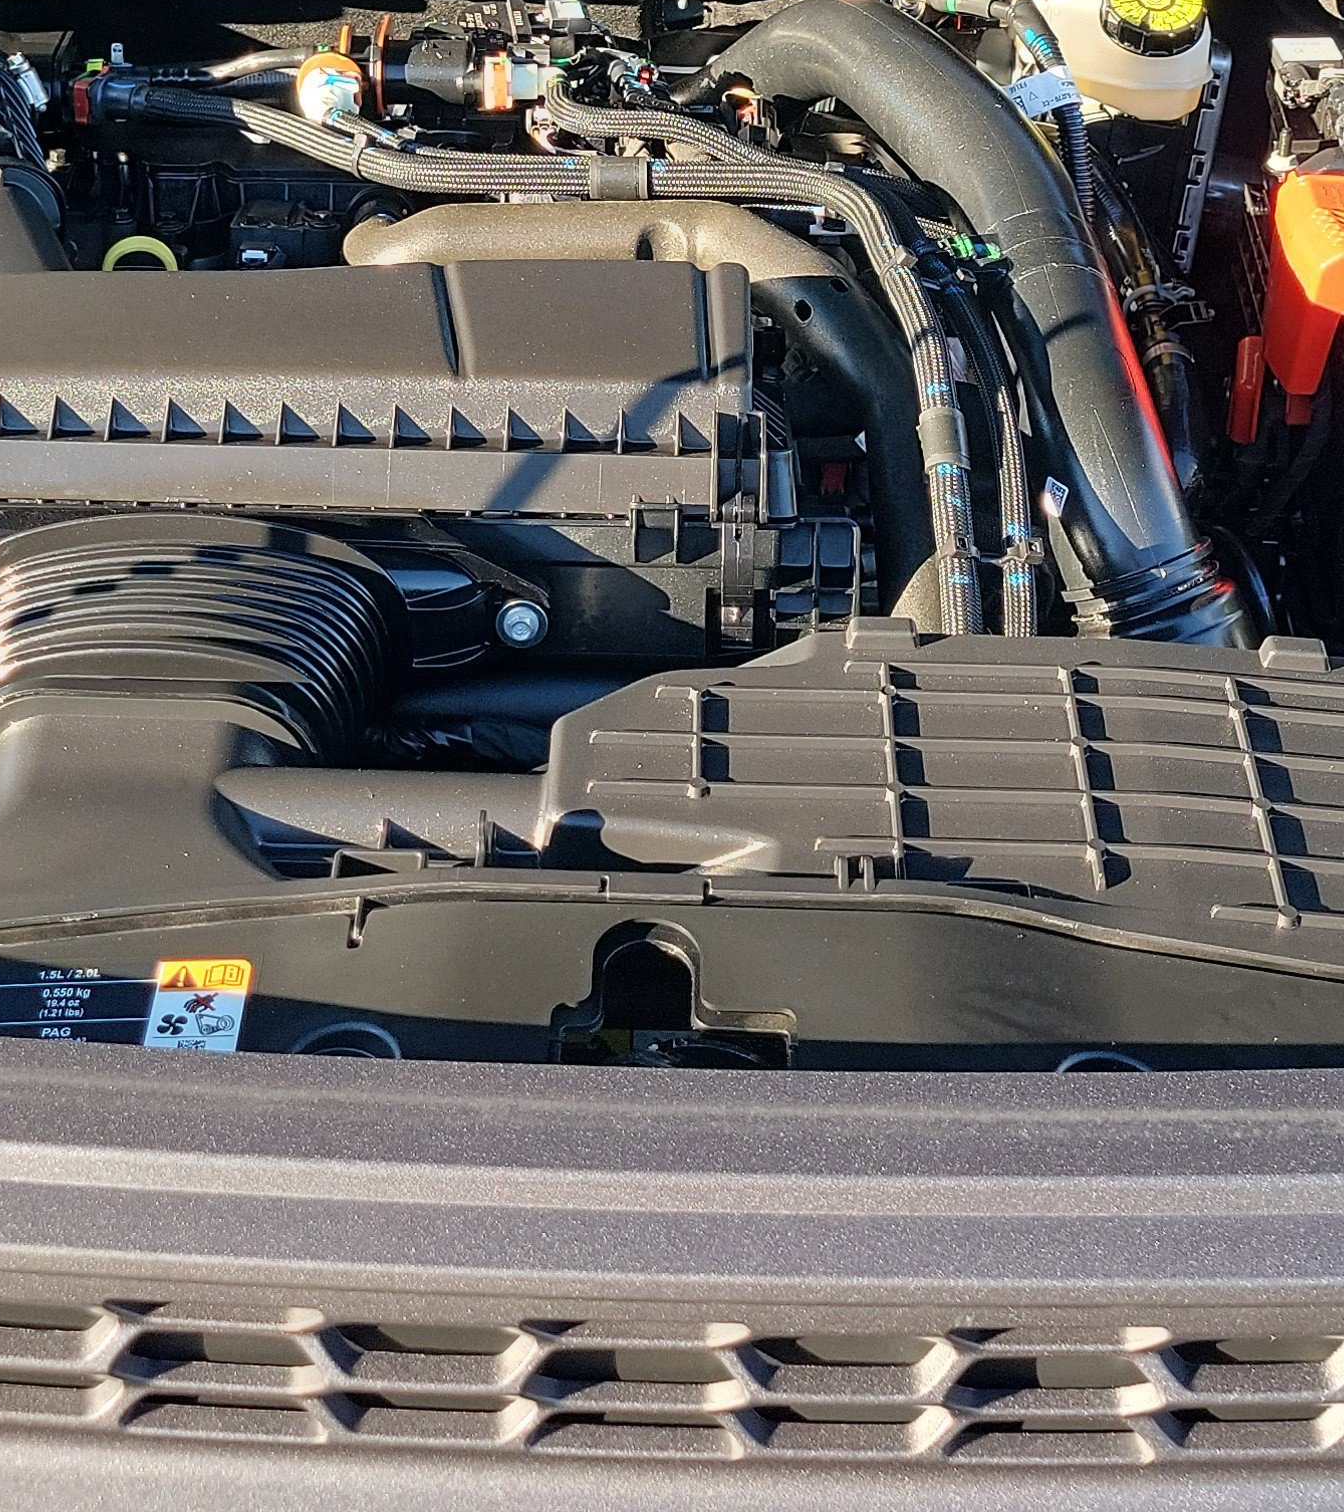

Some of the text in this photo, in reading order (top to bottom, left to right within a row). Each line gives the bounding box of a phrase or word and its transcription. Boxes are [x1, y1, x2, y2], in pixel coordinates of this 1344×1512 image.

[39, 970, 65, 980] 1.5L
[75, 968, 101, 979] 2.0L
[76, 987, 92, 999] kg
[41, 1027, 72, 1038] PAG
